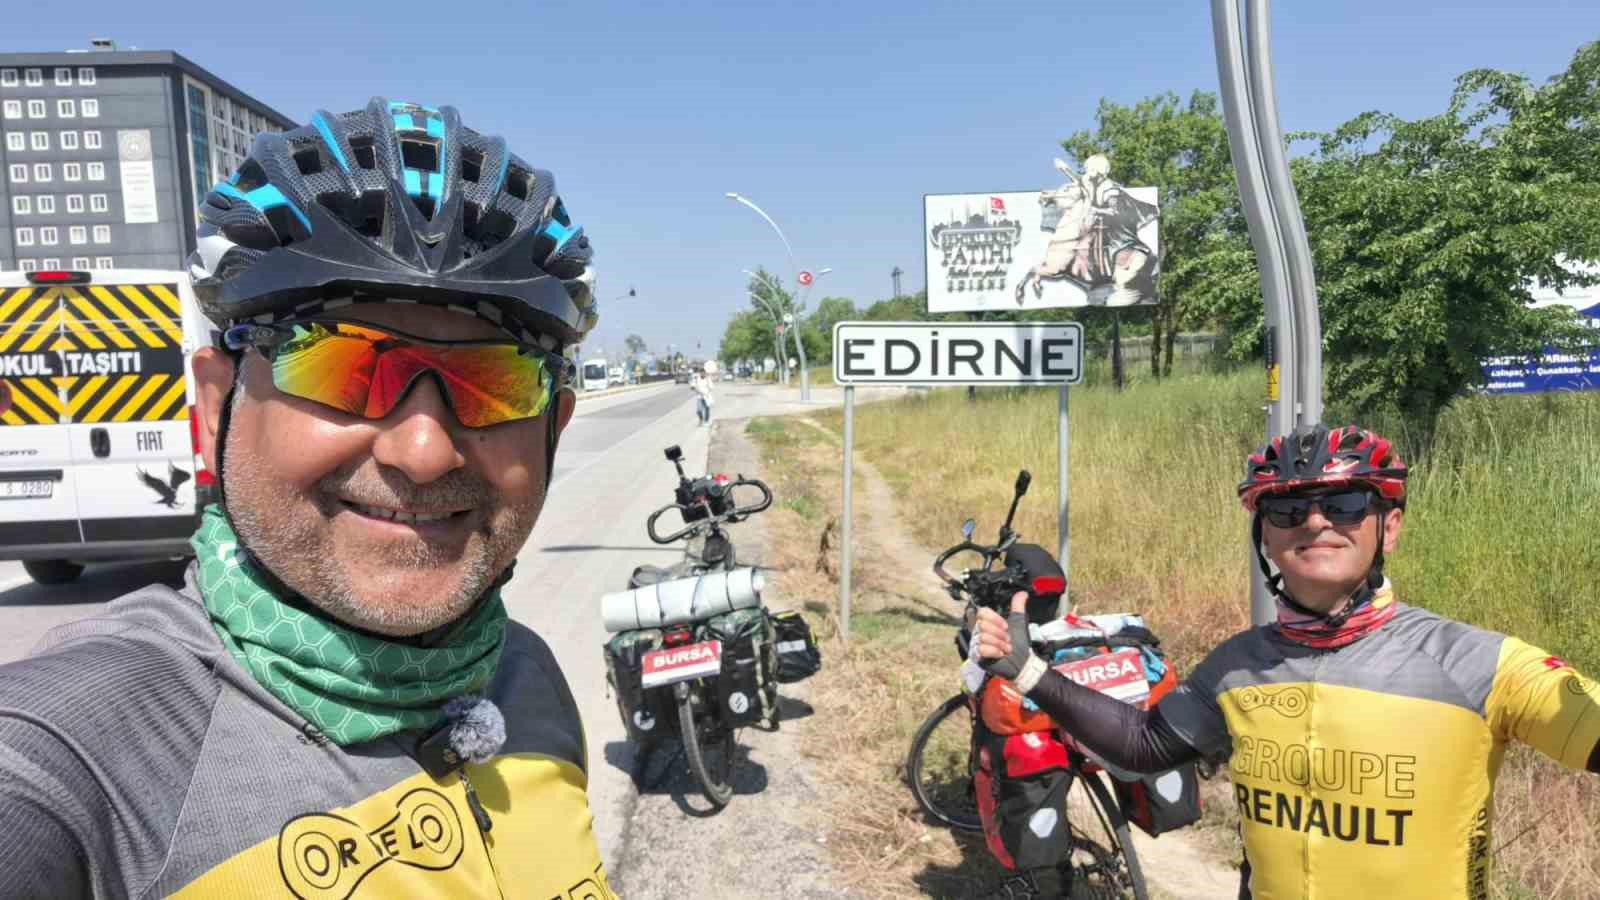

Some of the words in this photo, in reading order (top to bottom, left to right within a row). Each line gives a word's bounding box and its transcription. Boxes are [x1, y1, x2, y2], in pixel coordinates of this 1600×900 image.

[67, 351, 141, 377] TAŞITI
[843, 331, 1074, 376] EDİRNE
[136, 431, 163, 452] FIAT
[653, 647, 713, 668] BURSA
[1064, 659, 1137, 686] URSA
[1234, 736, 1416, 799] GROUPE
[1235, 783, 1412, 846] RENAULT
